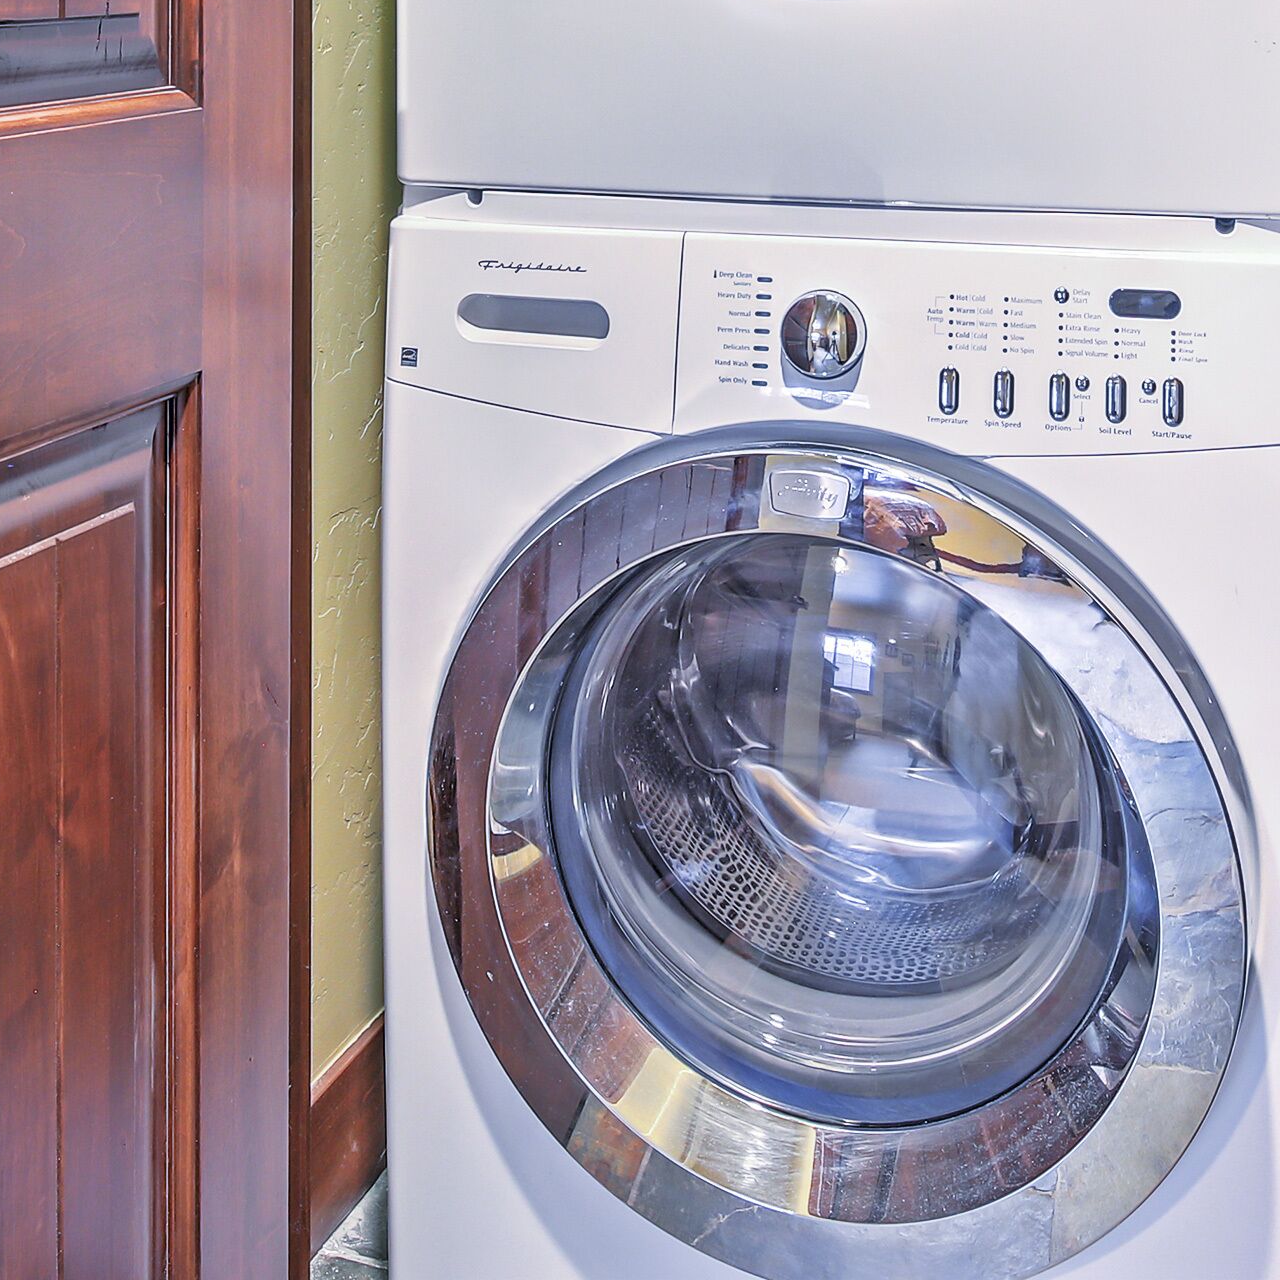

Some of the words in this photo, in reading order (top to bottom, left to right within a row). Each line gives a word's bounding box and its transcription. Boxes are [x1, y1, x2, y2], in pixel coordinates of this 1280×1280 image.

[478, 260, 587, 273] Frigidaire
[719, 271, 735, 279] Deep
[737, 292, 751, 300] Duty
[1072, 288, 1091, 297] Delay
[971, 294, 986, 302] Cold
[979, 307, 994, 315] Cold
[926, 315, 944, 323] Temp
[1083, 312, 1102, 320] Clean
[1121, 327, 1141, 335] Heavy
[1094, 338, 1108, 346] Spin
[723, 343, 751, 351] Delicates
[972, 344, 987, 352] Cold
[1065, 350, 1084, 358] Signal
[1084, 350, 1109, 358] Volume
[1121, 352, 1138, 360] Light
[733, 377, 747, 385] Only
[927, 415, 969, 425] Temperature
[984, 419, 999, 428] Spin
[1001, 420, 1021, 429] Speed
[1044, 424, 1072, 432] Options
[1098, 427, 1112, 435] Soil
[1113, 428, 1132, 436] Level
[1151, 430, 1193, 440] Start/Pause
